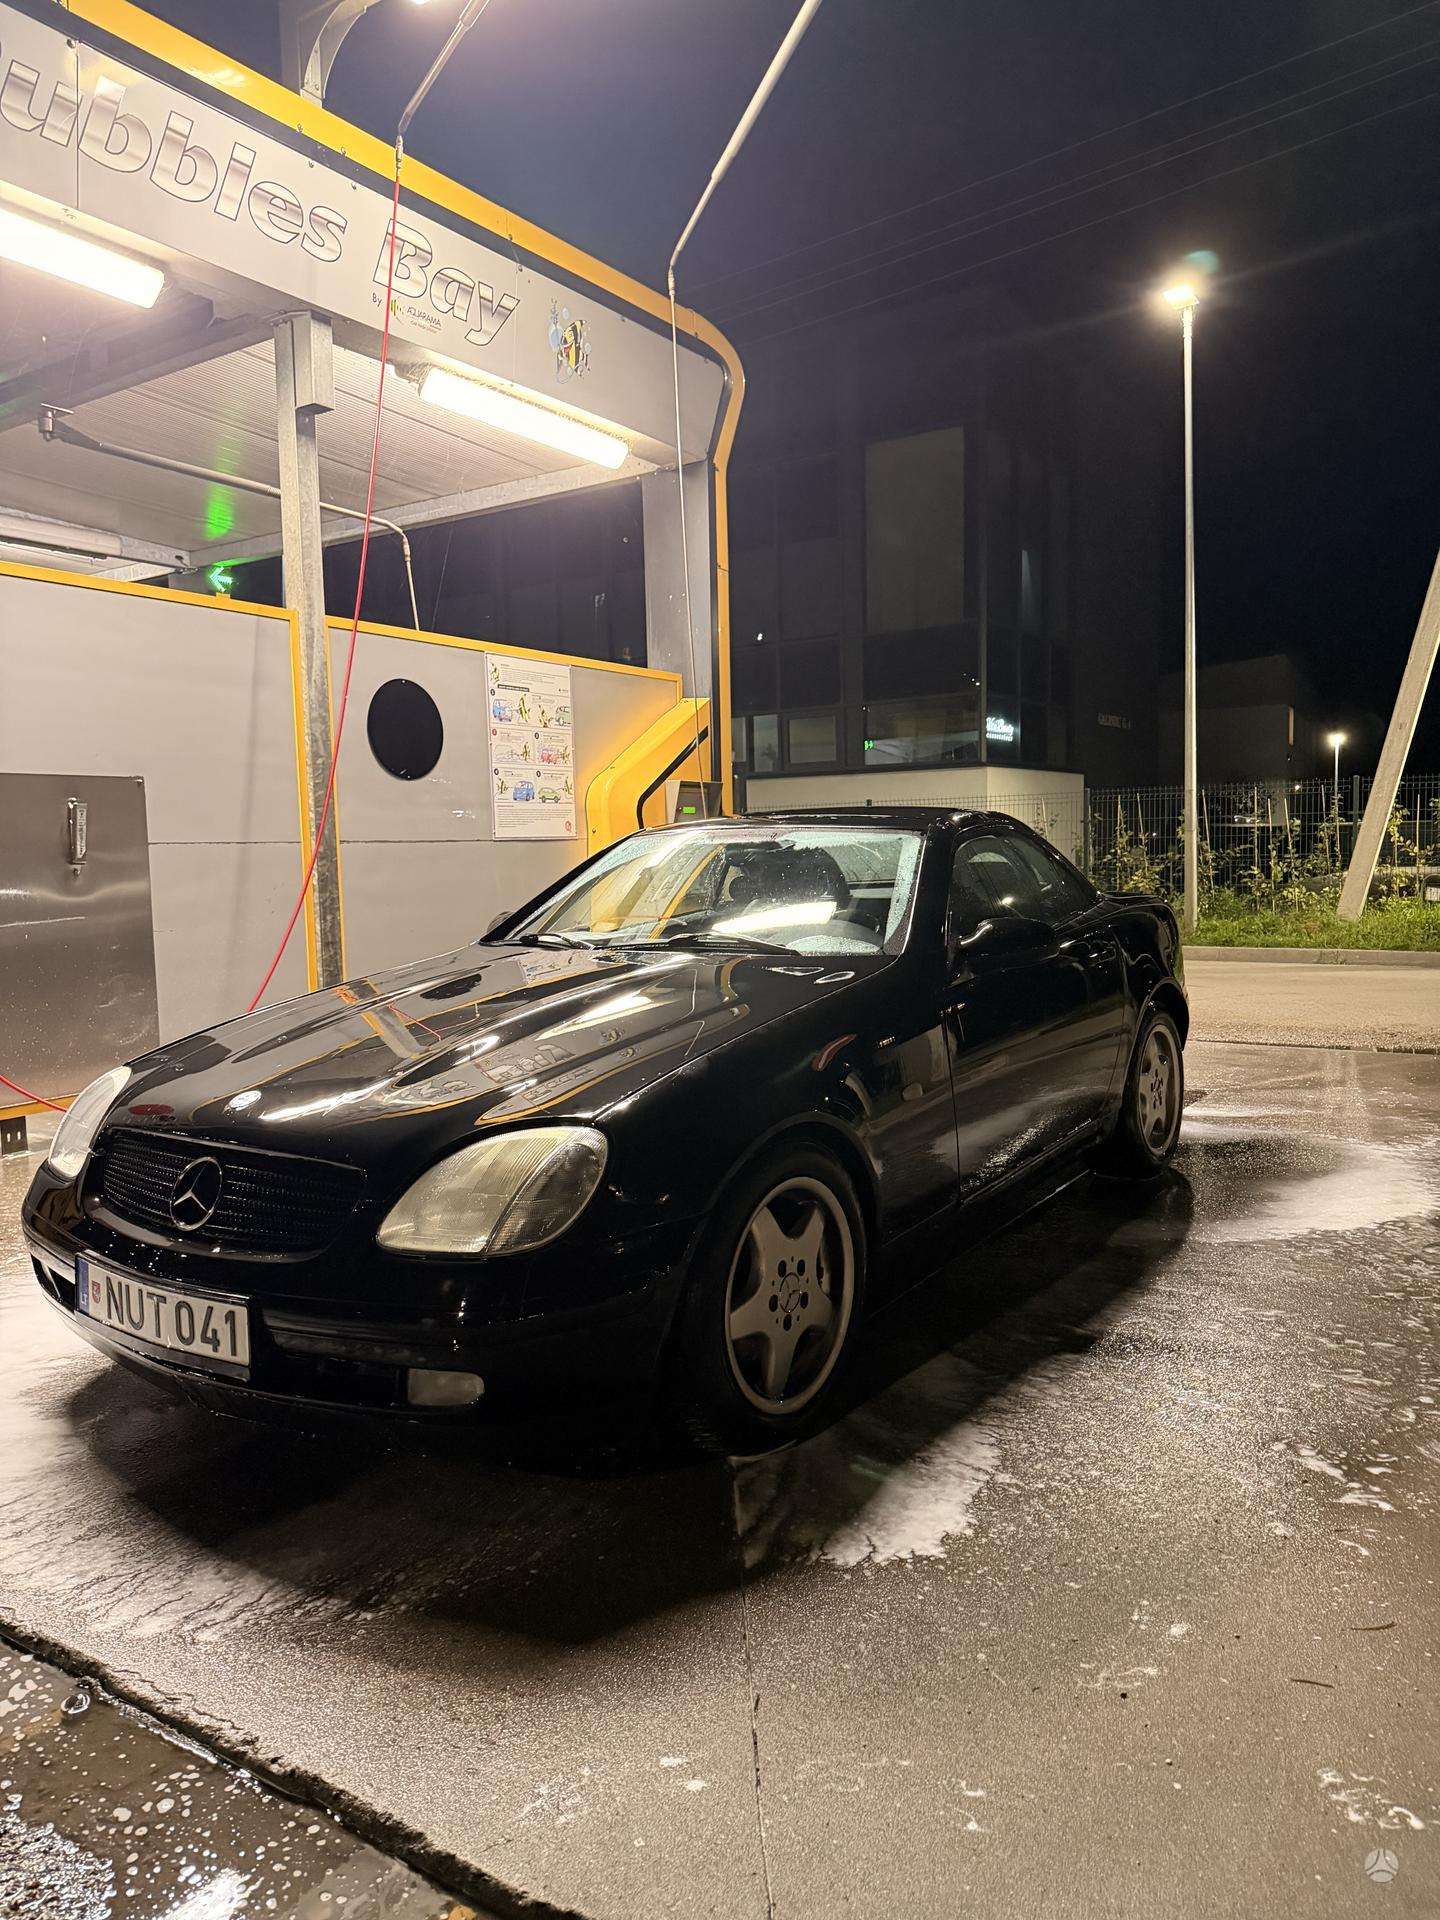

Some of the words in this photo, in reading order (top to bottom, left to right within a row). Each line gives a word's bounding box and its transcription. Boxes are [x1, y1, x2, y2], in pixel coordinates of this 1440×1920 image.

[0, 42, 348, 263] ubbles
[372, 218, 521, 346] Bay
[372, 292, 383, 308] By
[106, 1275, 167, 1339] NUT
[174, 1300, 238, 1357] 041
